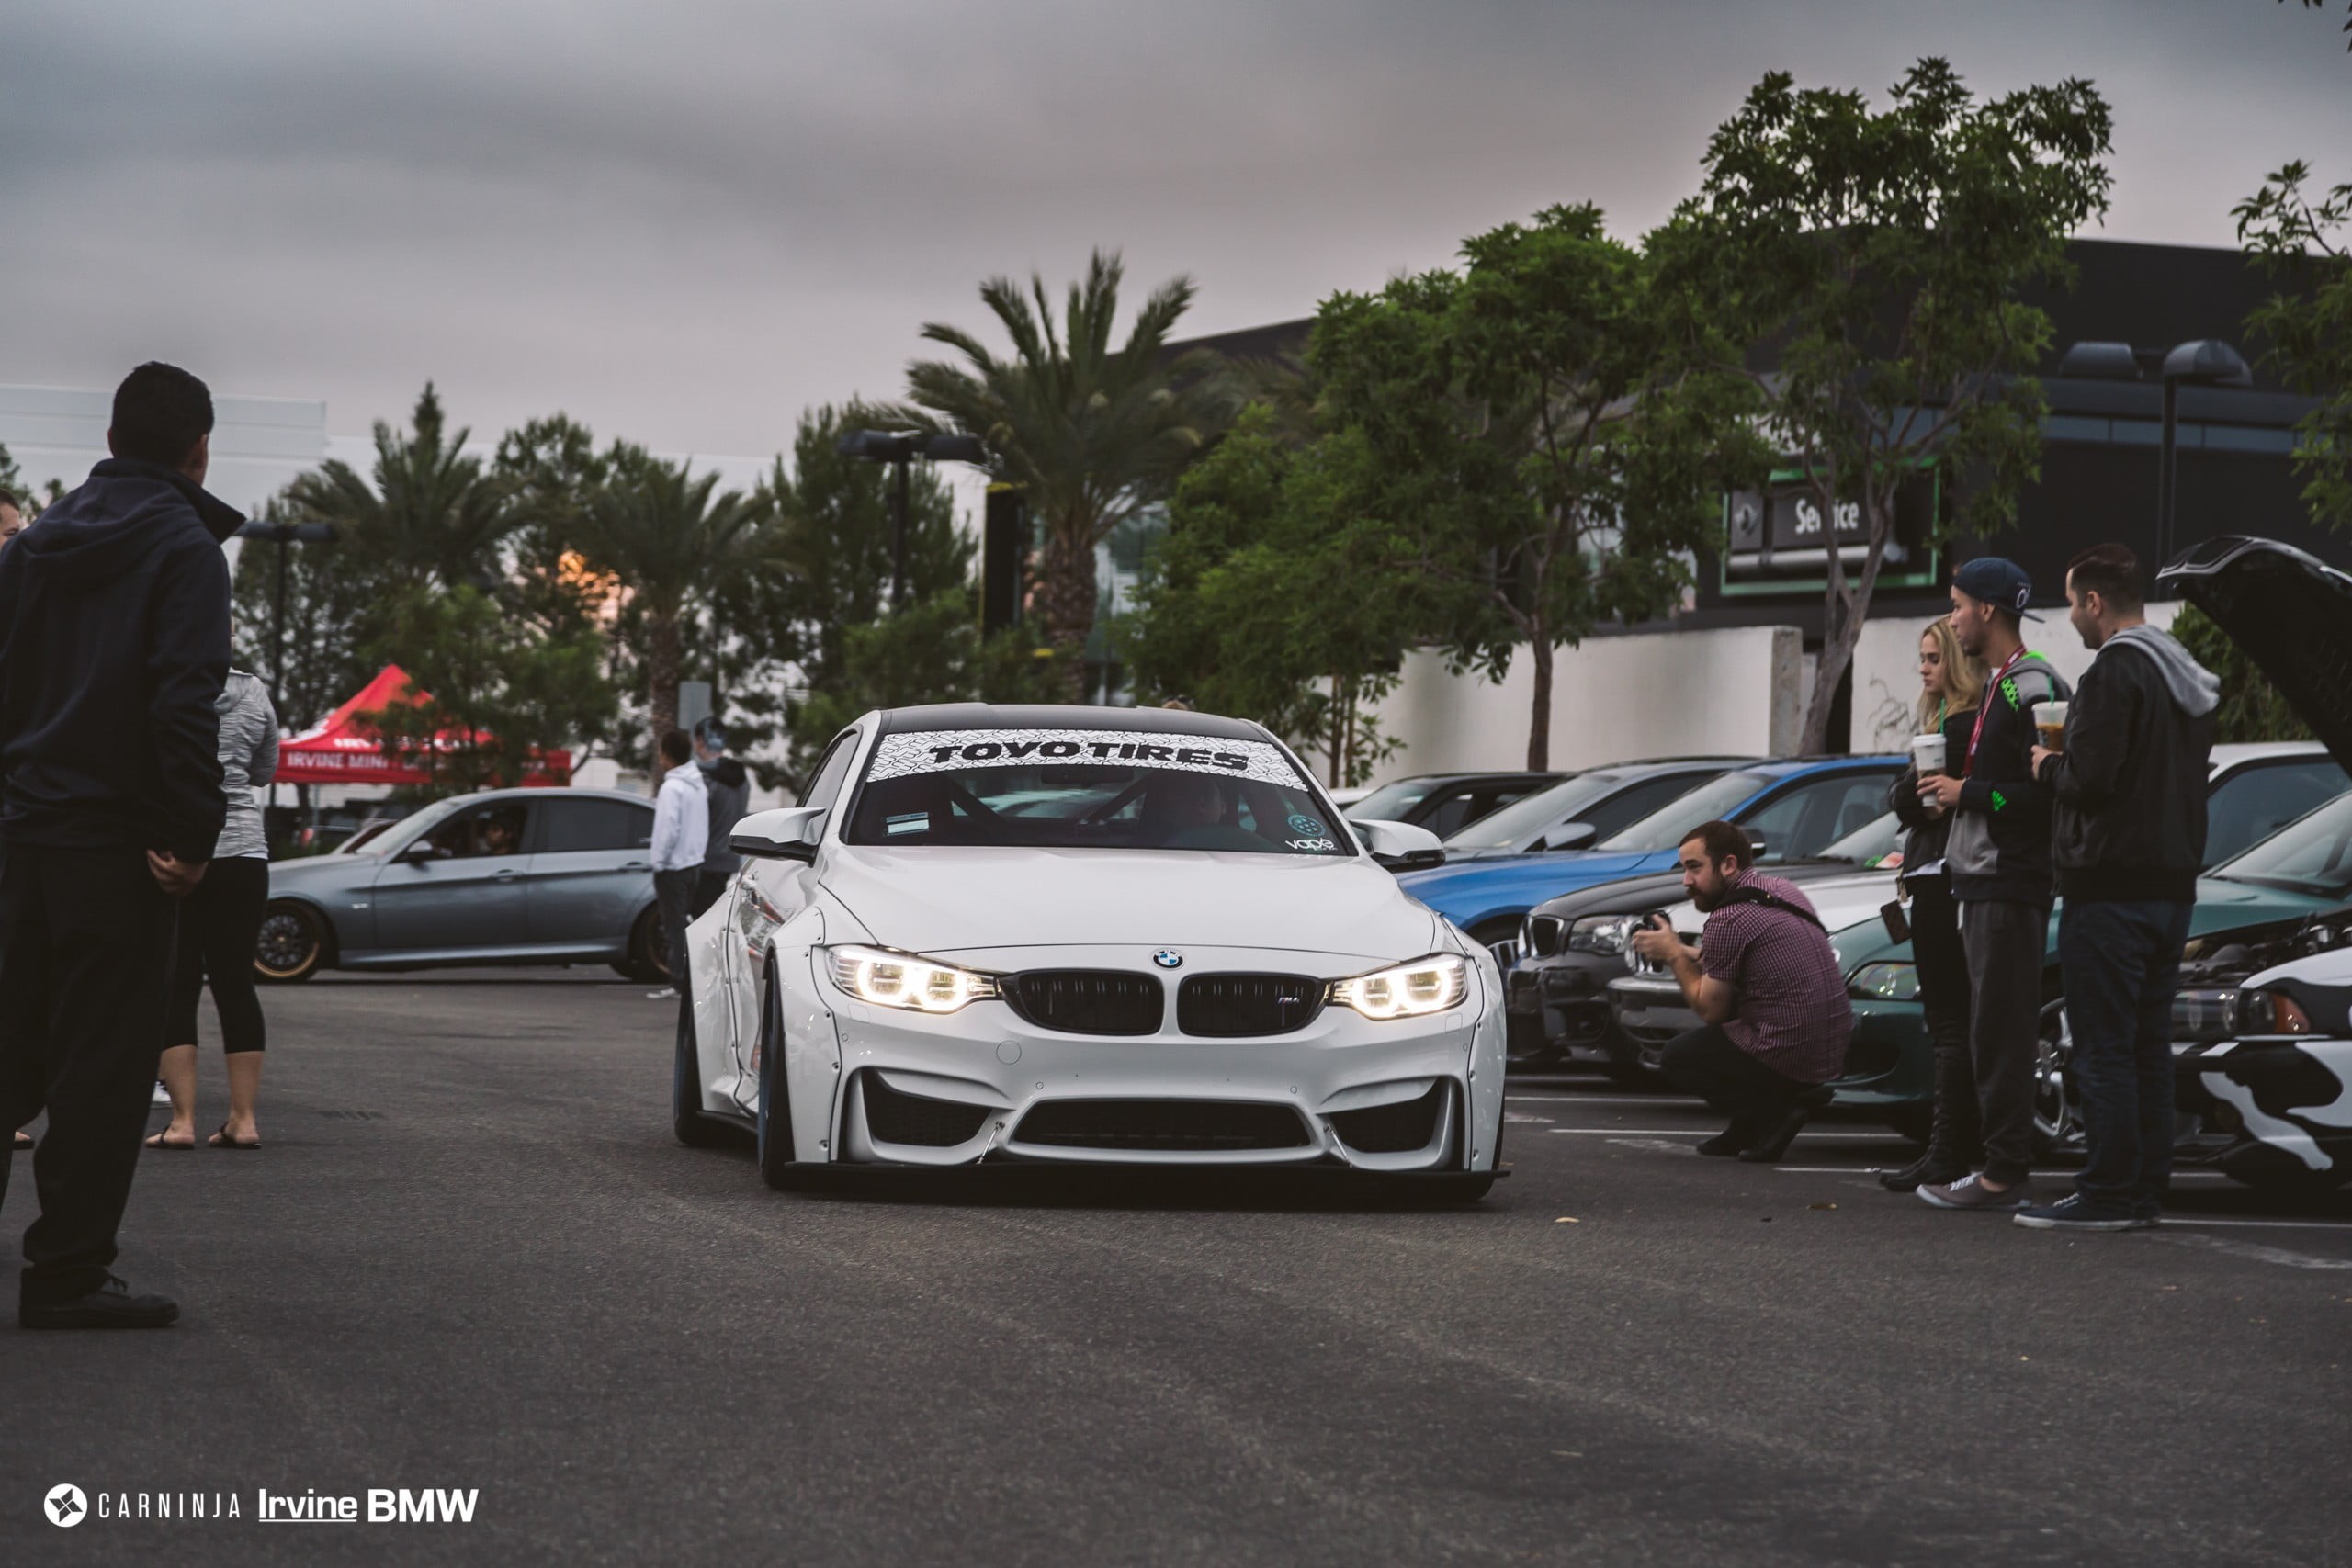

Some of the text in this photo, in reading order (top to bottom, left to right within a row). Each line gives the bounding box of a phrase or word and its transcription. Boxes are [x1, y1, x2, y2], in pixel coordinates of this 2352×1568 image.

[1795, 498, 1860, 535] Serice
[288, 751, 345, 770] IRVINE
[929, 741, 1249, 771] TOYO TIRES
